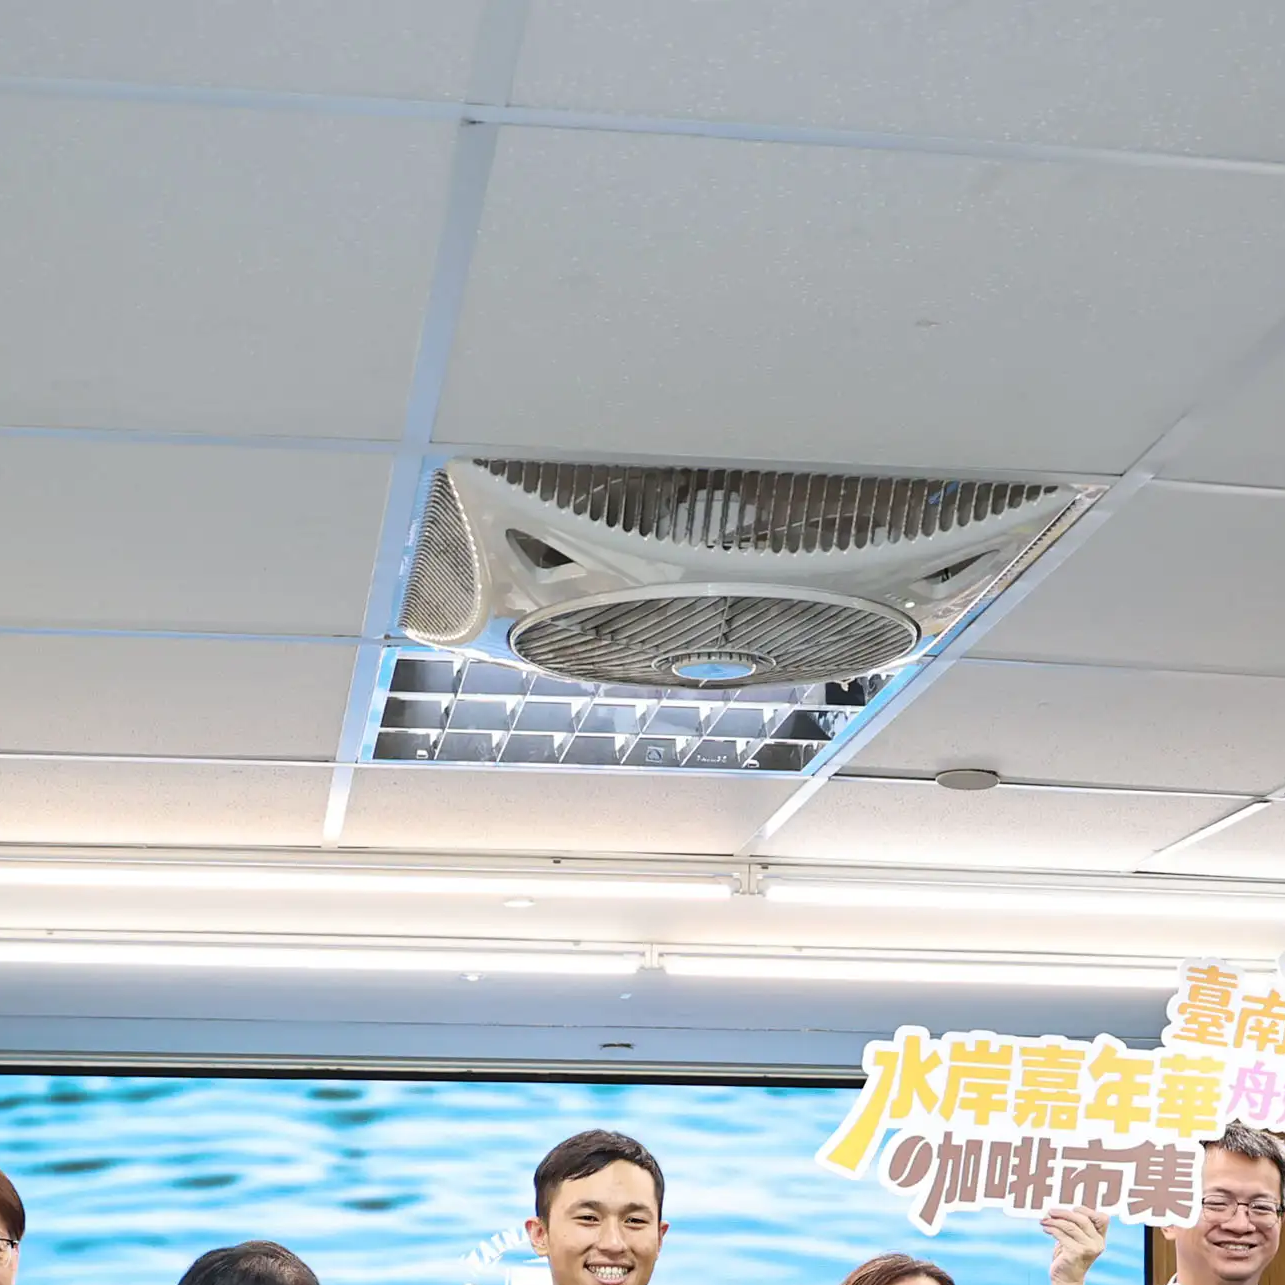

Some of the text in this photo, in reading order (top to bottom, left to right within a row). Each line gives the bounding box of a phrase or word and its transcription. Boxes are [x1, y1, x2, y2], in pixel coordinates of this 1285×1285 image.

[826, 1035, 1226, 1172] 水岸嘉年華
